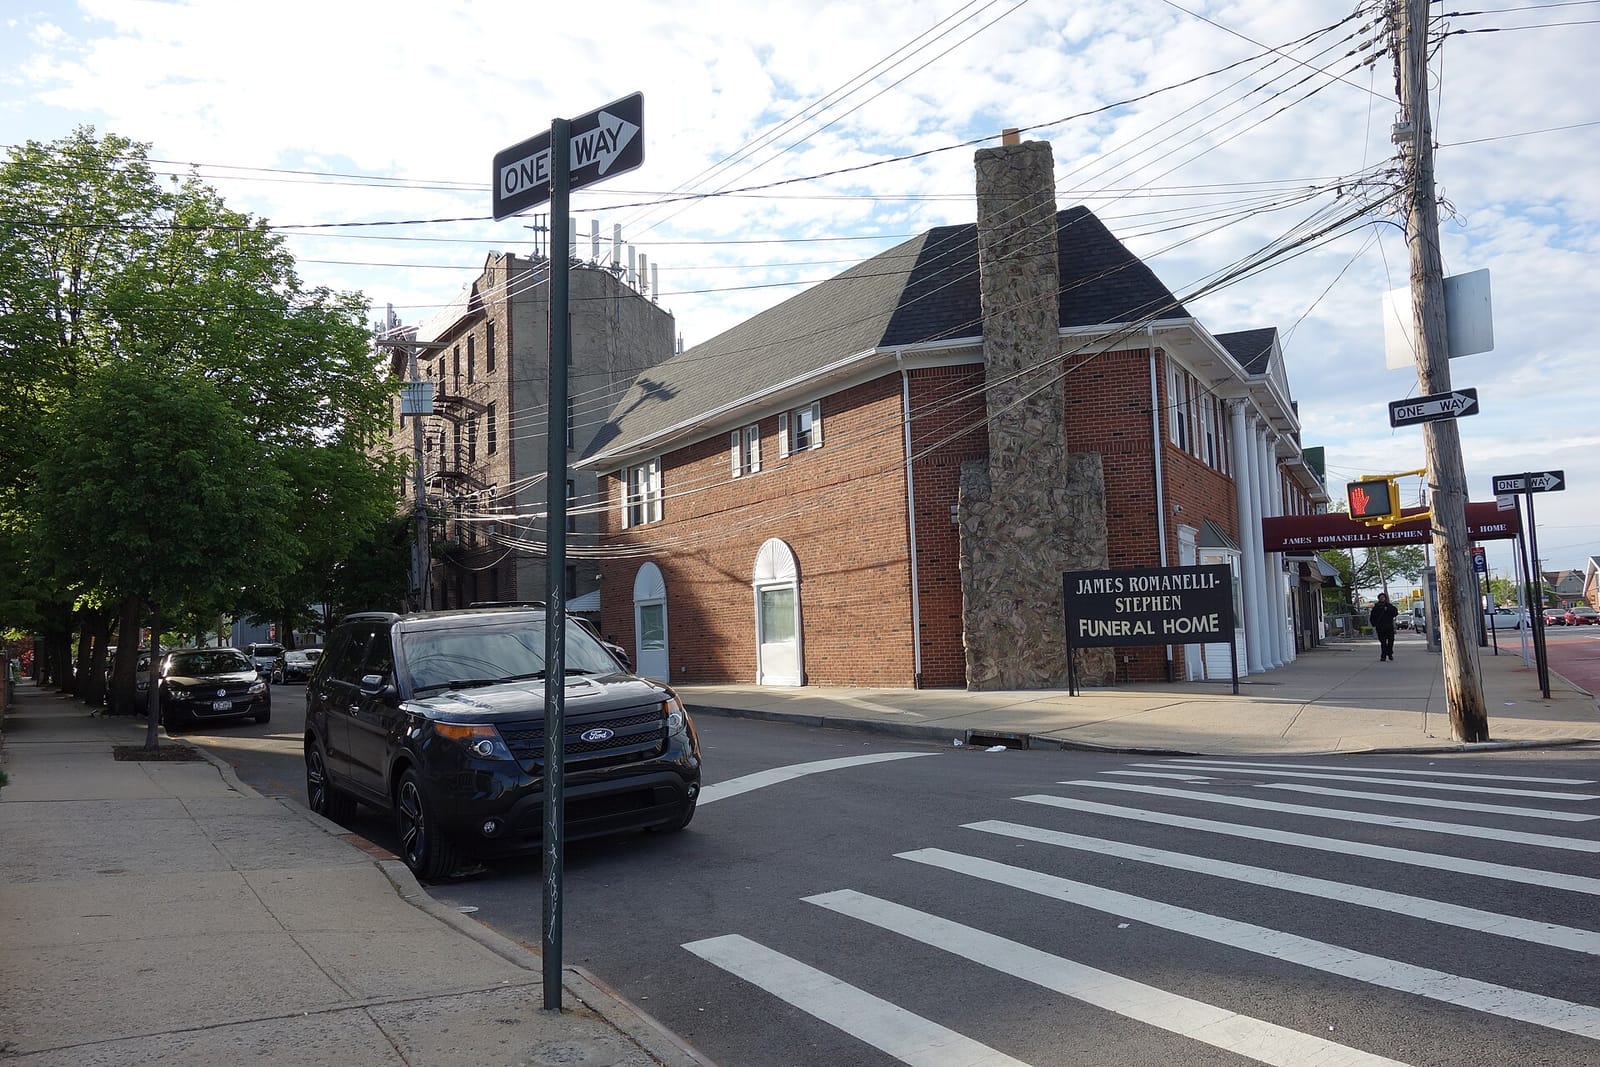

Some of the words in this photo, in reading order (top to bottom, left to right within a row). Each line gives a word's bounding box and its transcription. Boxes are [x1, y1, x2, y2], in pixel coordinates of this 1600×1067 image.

[505, 153, 549, 194] ONE
[575, 121, 624, 165] WAY
[1397, 404, 1425, 420] ONE
[1439, 397, 1467, 412] WAY
[1499, 480, 1519, 490] ONE
[1530, 477, 1551, 487] WAY
[1282, 536, 1312, 545] JAMES
[1480, 523, 1507, 533] HOME
[1076, 577, 1124, 595] JAMES
[1129, 573, 1221, 593] ROMANELLI-
[1115, 595, 1182, 613] STEPHEN
[1079, 618, 1155, 638] FUNERAL
[1163, 613, 1220, 634] HOME
[589, 730, 607, 740] Ford
